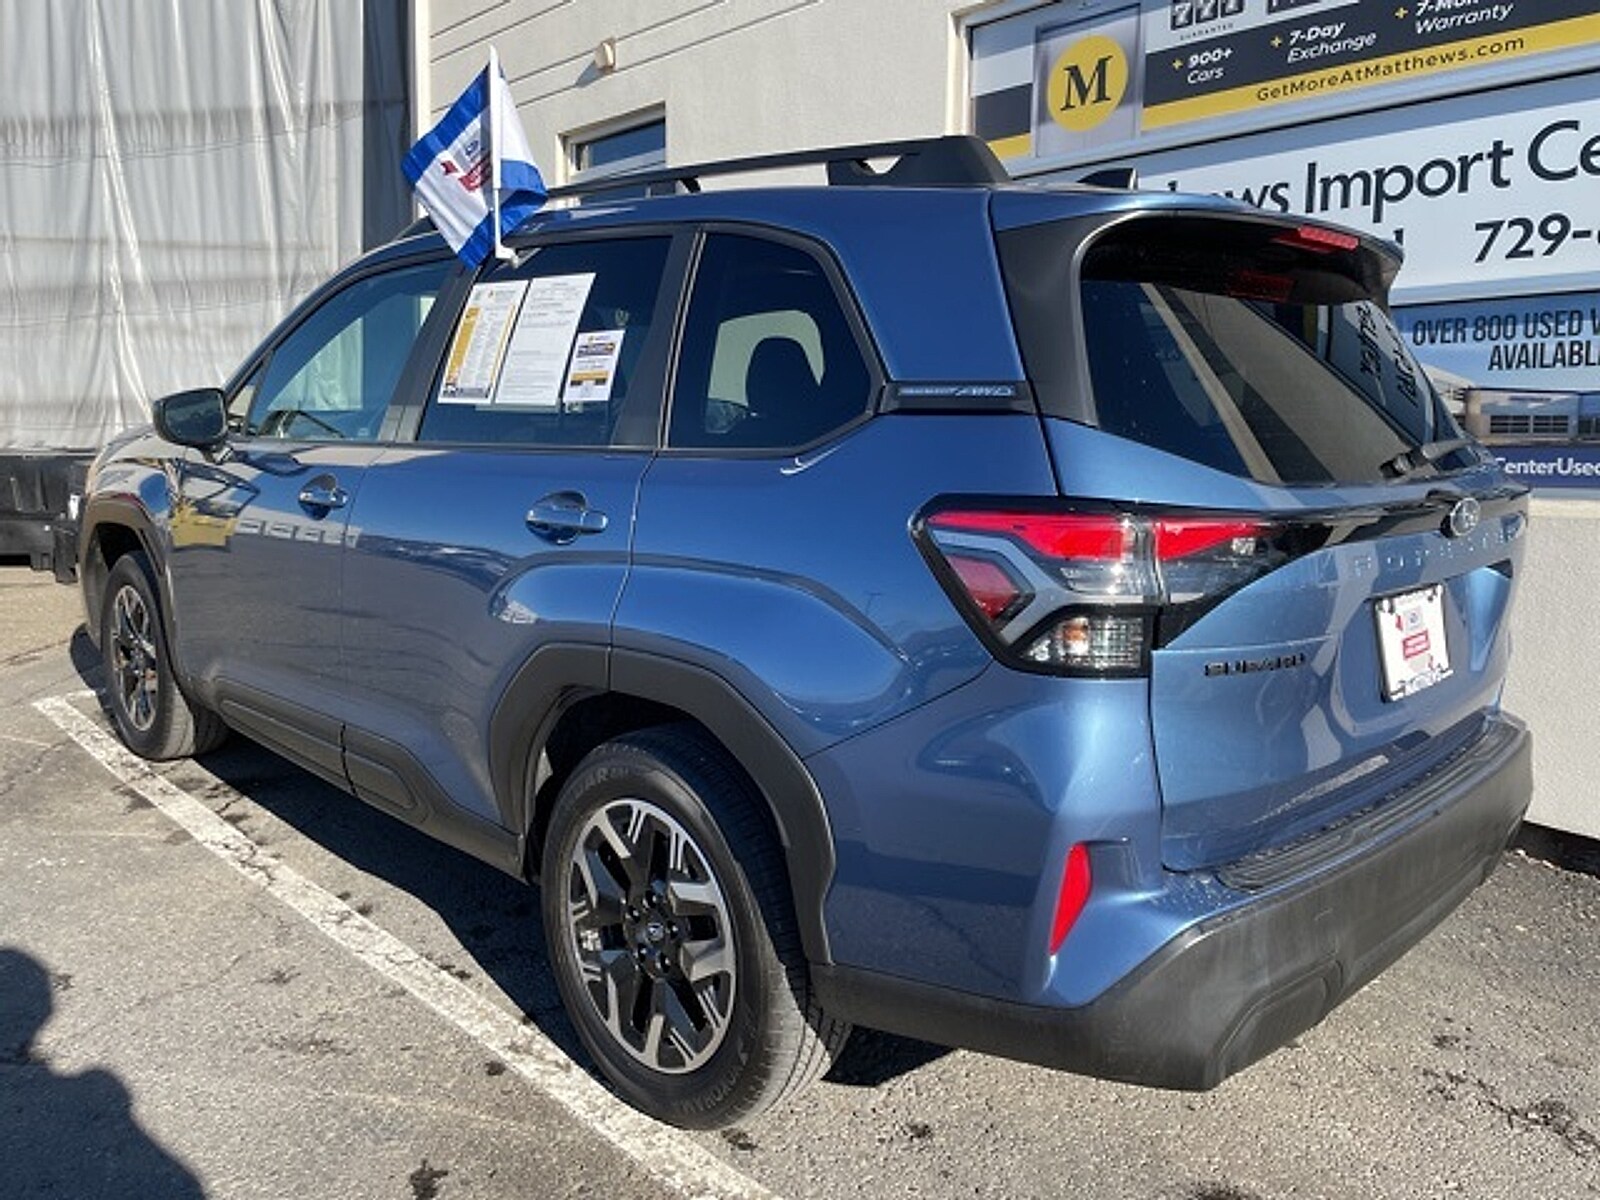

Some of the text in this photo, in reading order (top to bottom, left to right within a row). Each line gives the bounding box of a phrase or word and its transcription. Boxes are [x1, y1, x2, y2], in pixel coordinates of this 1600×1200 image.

[1288, 22, 1346, 46] 7-Day
[1415, 3, 1514, 34] Warranty
[1187, 47, 1233, 69] 900+
[1287, 33, 1377, 63] Exchange
[1060, 55, 1113, 111] M
[1187, 66, 1225, 84] Cars
[1257, 38, 1525, 101] GetMoreAtMatthews.com
[1305, 139, 1514, 223] Import
[1474, 212, 1600, 264] 729-
[1412, 317, 1467, 346] OVER
[1472, 314, 1517, 342] 800
[1524, 310, 1584, 339] USED
[1487, 340, 1600, 372] AVAILABL
